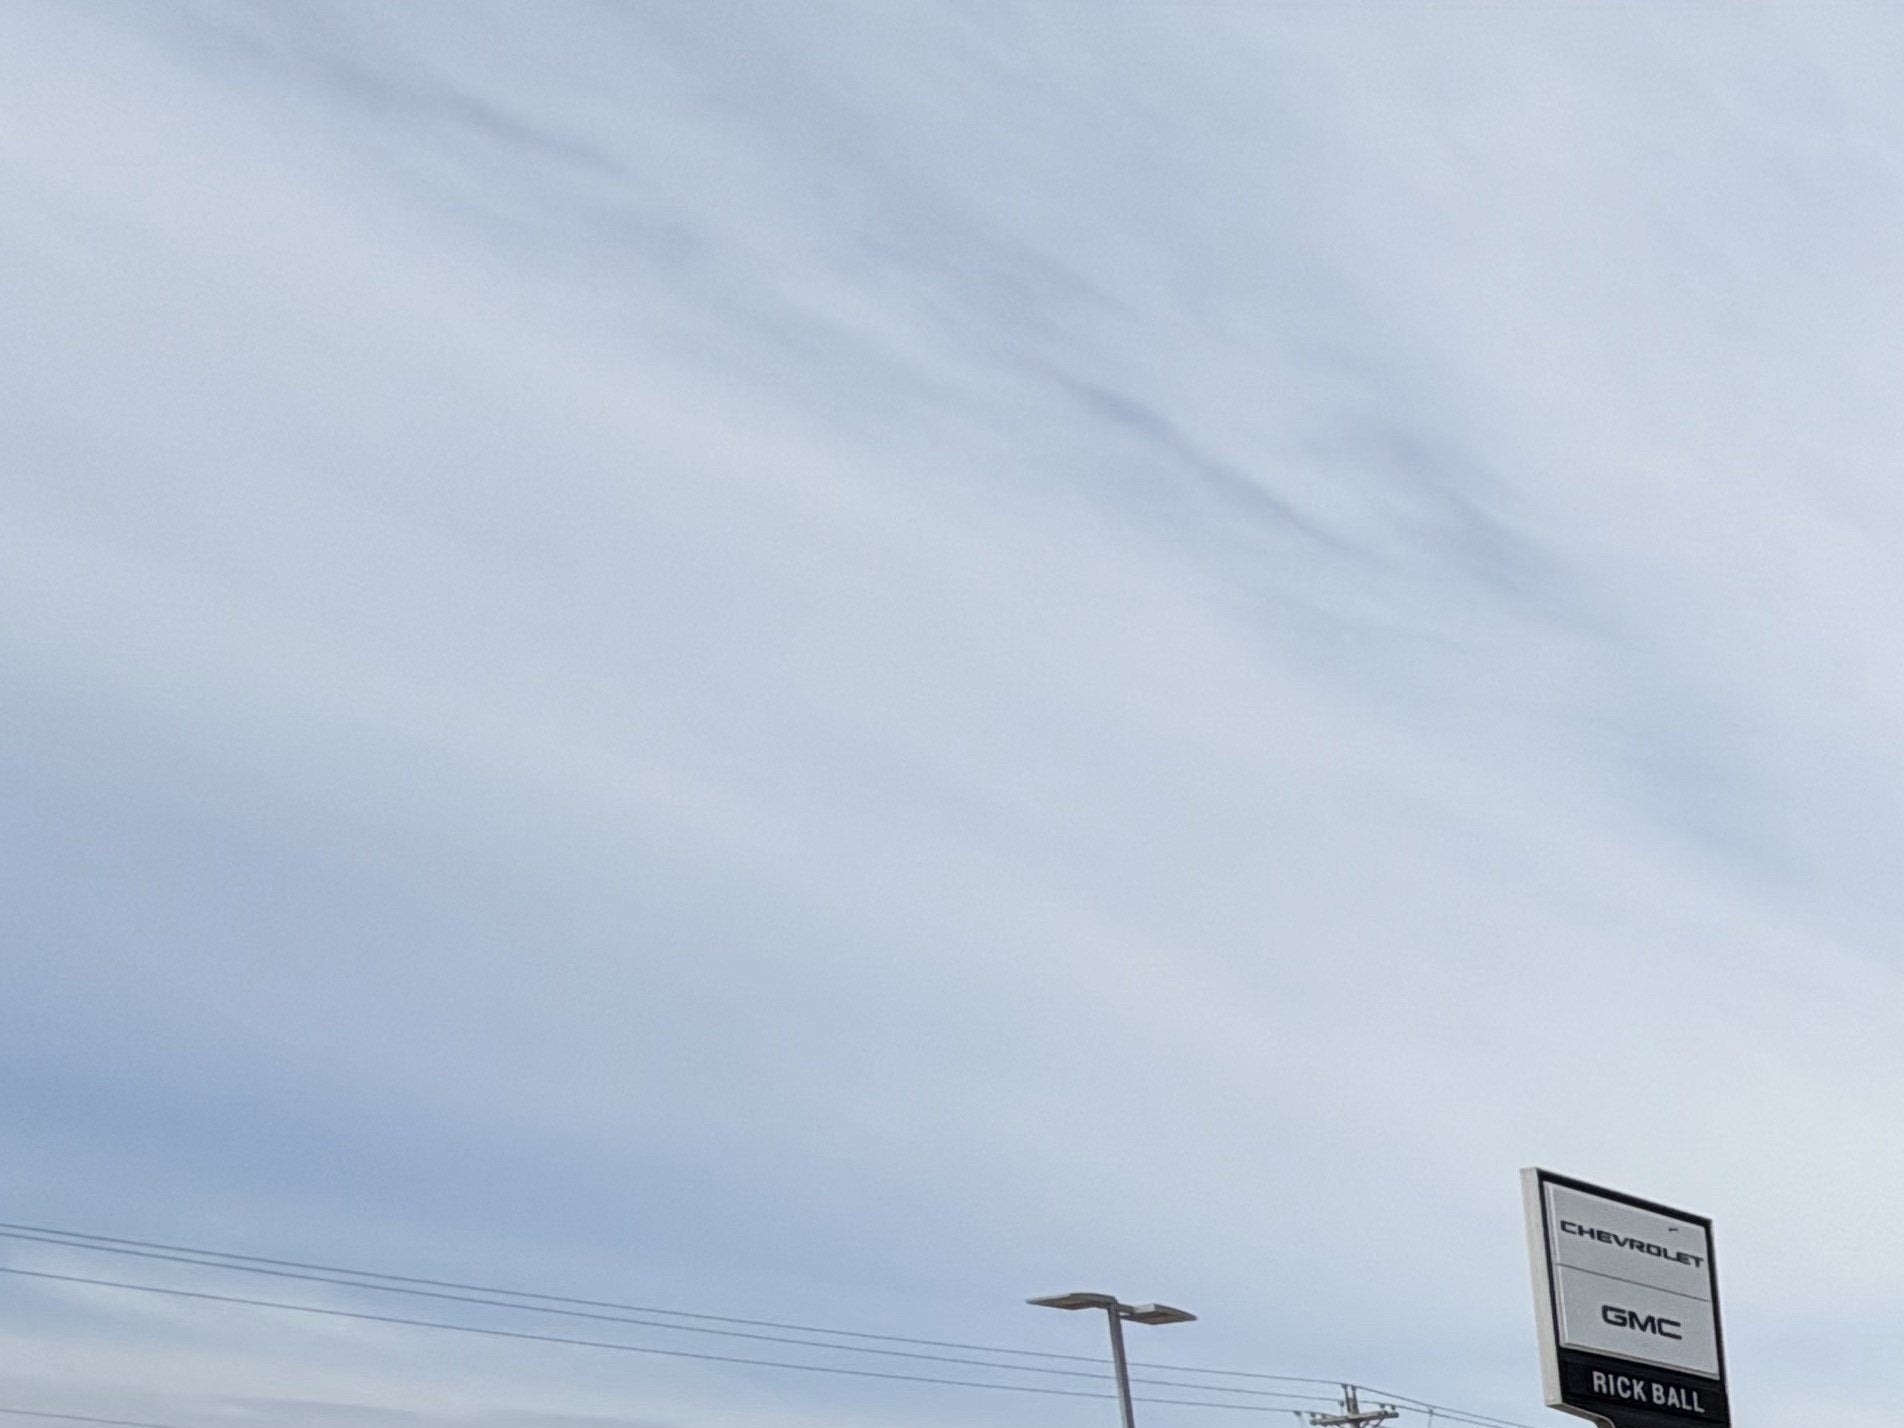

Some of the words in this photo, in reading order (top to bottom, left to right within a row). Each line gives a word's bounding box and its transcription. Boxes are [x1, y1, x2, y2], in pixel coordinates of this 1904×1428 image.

[1559, 1218, 1705, 1268] CHEVROLET
[1601, 1303, 1683, 1341] GMC
[1592, 1370, 1648, 1402] RICK
[1651, 1382, 1706, 1414] BALL
